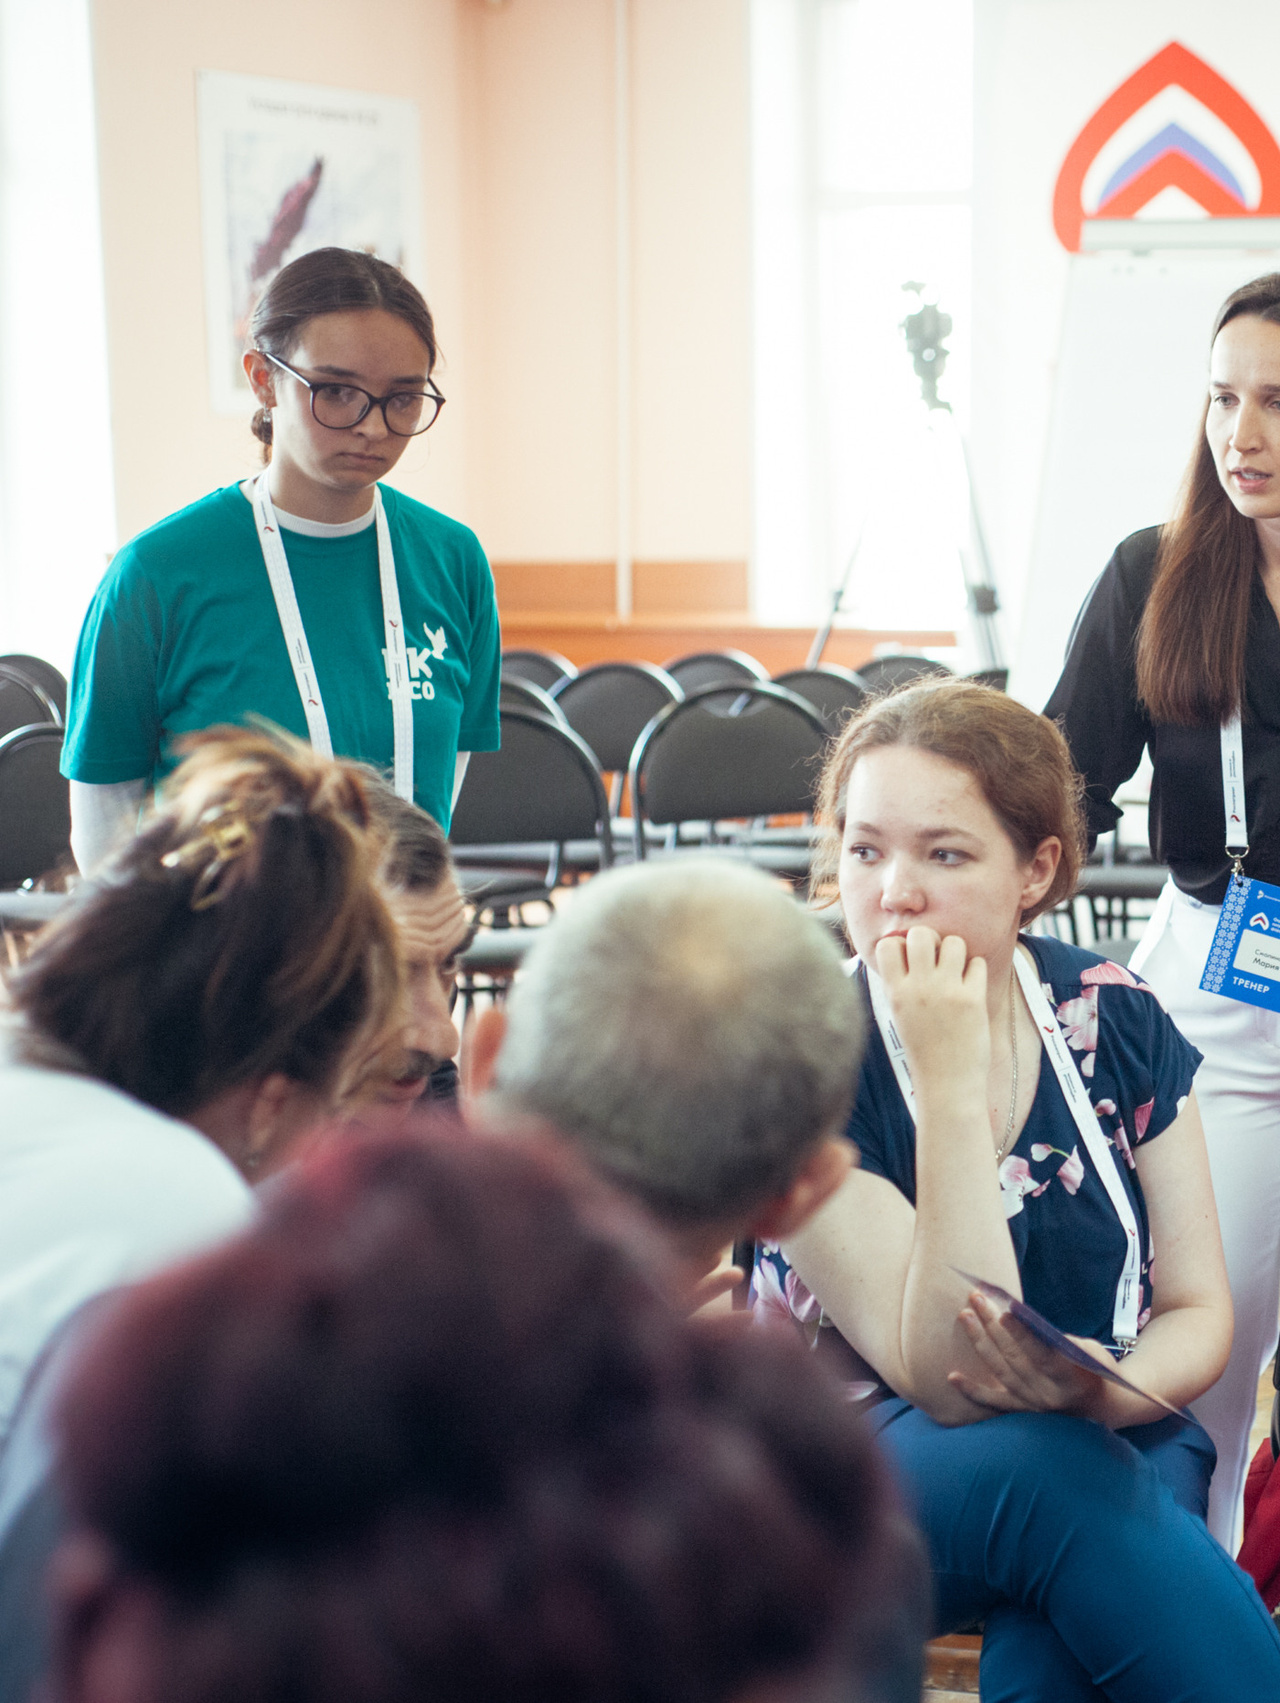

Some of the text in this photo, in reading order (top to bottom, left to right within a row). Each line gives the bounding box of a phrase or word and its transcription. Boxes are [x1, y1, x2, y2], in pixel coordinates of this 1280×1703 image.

[381, 647, 433, 679] К
[386, 680, 435, 700] СО
[1252, 957, 1280, 971] Мария
[1232, 976, 1270, 993] ТРЕНЕР
